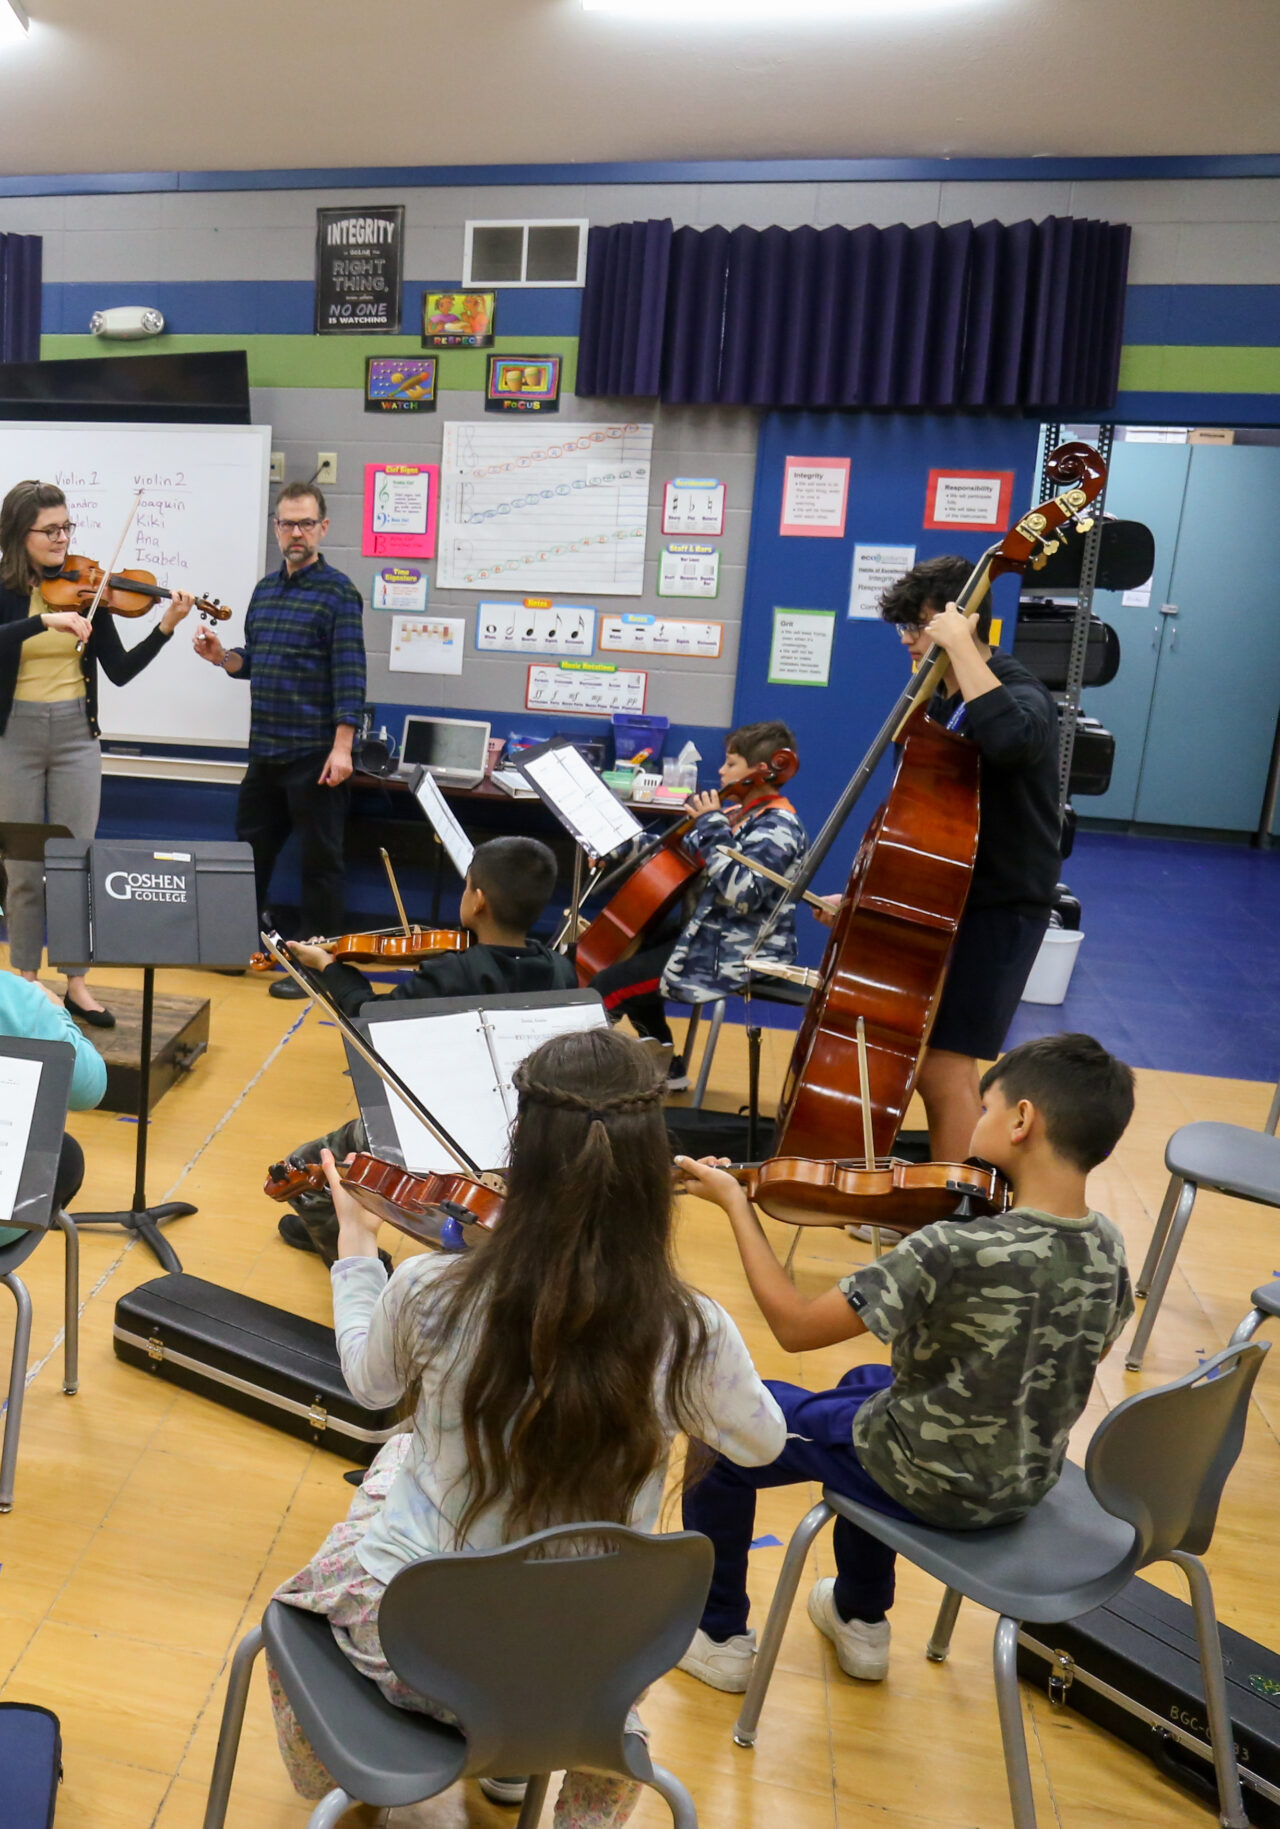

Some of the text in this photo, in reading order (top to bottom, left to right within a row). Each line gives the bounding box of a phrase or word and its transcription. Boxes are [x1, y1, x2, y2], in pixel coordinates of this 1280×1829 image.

[327, 218, 395, 245] INTEGRITY
[333, 259, 386, 275] RIGHT
[332, 276, 389, 292] THING,
[330, 303, 387, 316] NO ONE
[340, 316, 387, 324] WATCHING
[434, 336, 483, 345] RESPECT
[381, 401, 418, 410] WATCH
[503, 401, 540, 410] FOCUS
[55, 471, 85, 486] Violin
[176, 472, 187, 487] 2
[794, 472, 824, 480] Integrity
[945, 484, 993, 493] Responsibility
[136, 514, 165, 529] Kiki
[136, 530, 160, 547] Ana
[135, 548, 189, 569] Isabela
[105, 871, 186, 900] GOSHEN
[135, 891, 187, 903] COLLEGE
